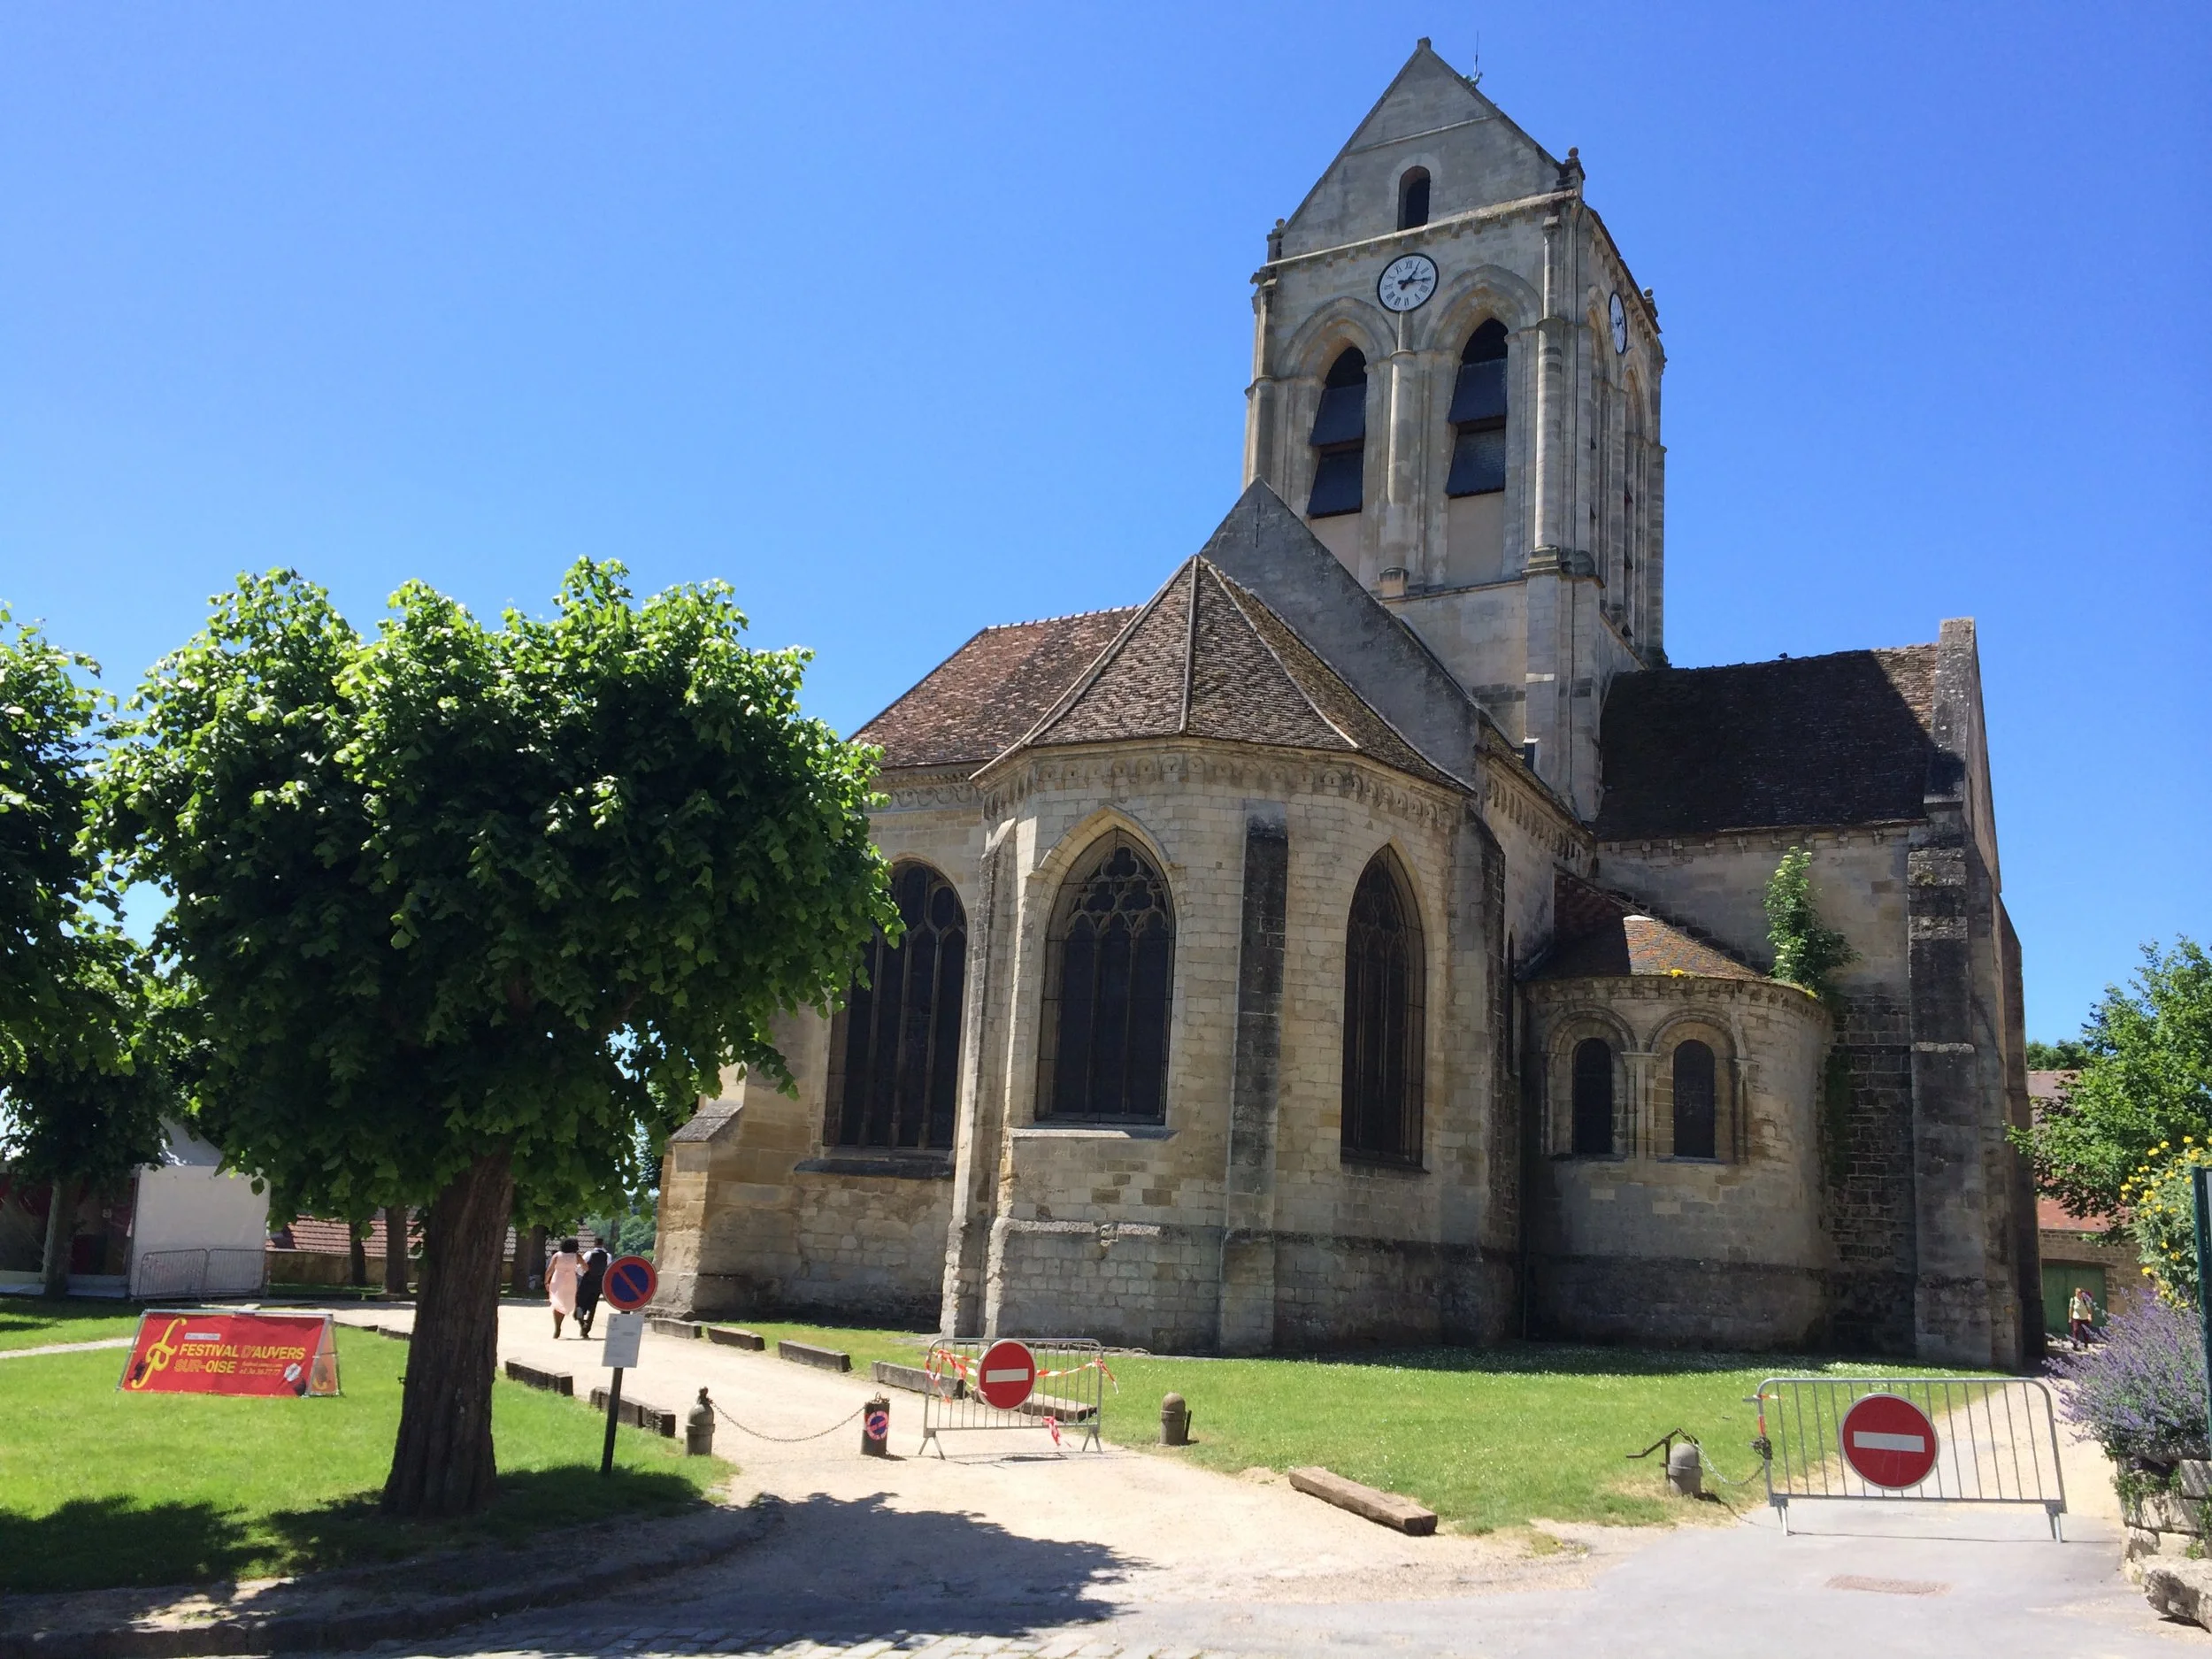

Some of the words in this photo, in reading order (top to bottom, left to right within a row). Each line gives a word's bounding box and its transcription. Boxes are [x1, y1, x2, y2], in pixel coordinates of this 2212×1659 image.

[179, 1343, 239, 1357] FESTIVAL
[241, 1345, 306, 1360] D'AUVERS
[174, 1359, 237, 1373] SUR-OISE
